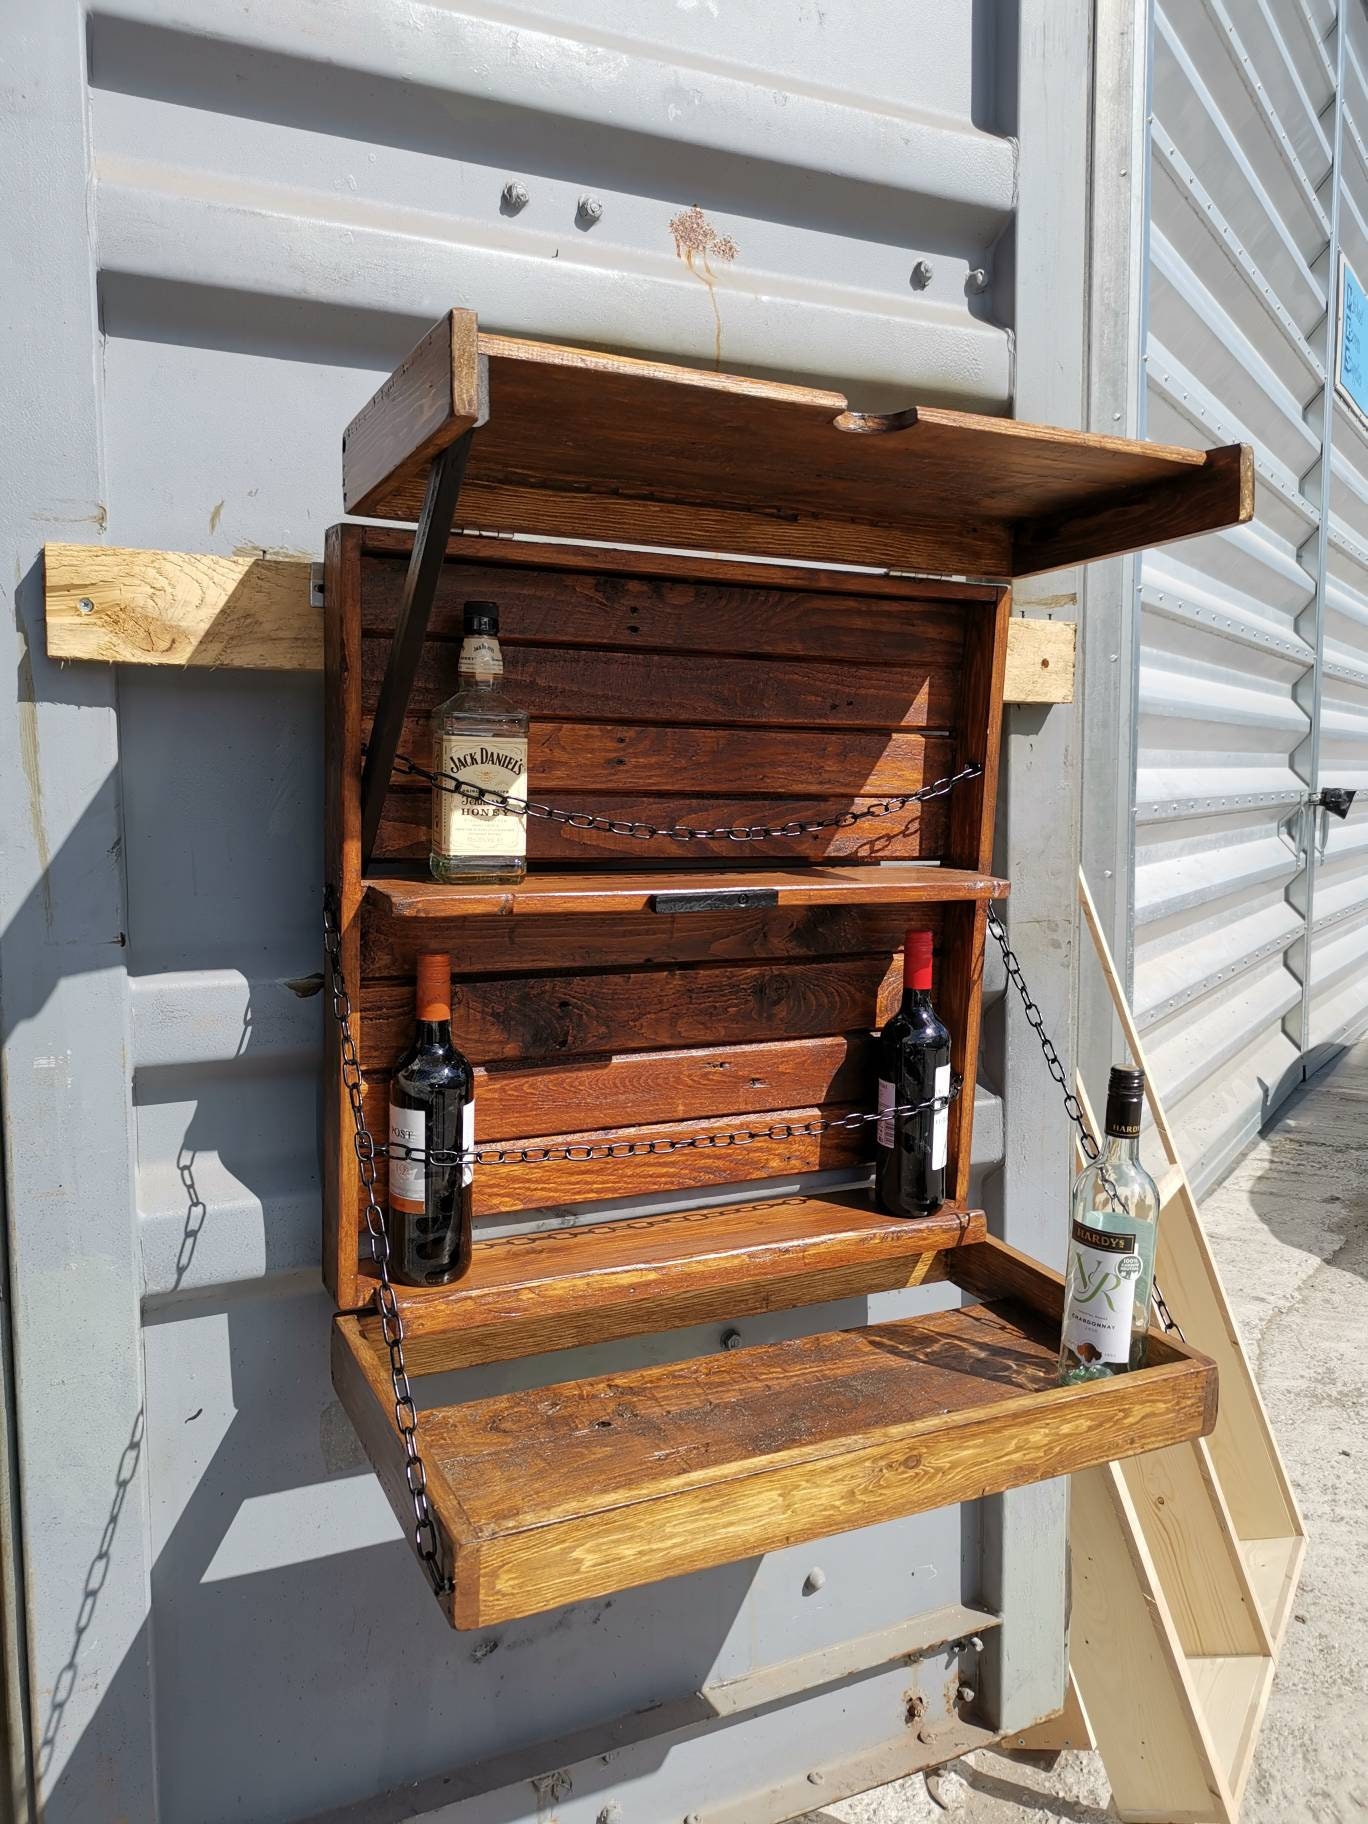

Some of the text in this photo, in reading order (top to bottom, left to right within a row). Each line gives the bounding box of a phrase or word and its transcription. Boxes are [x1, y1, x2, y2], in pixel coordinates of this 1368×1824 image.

[450, 747, 523, 776] JACK DANIEL'S
[461, 808, 511, 817] HONEY
